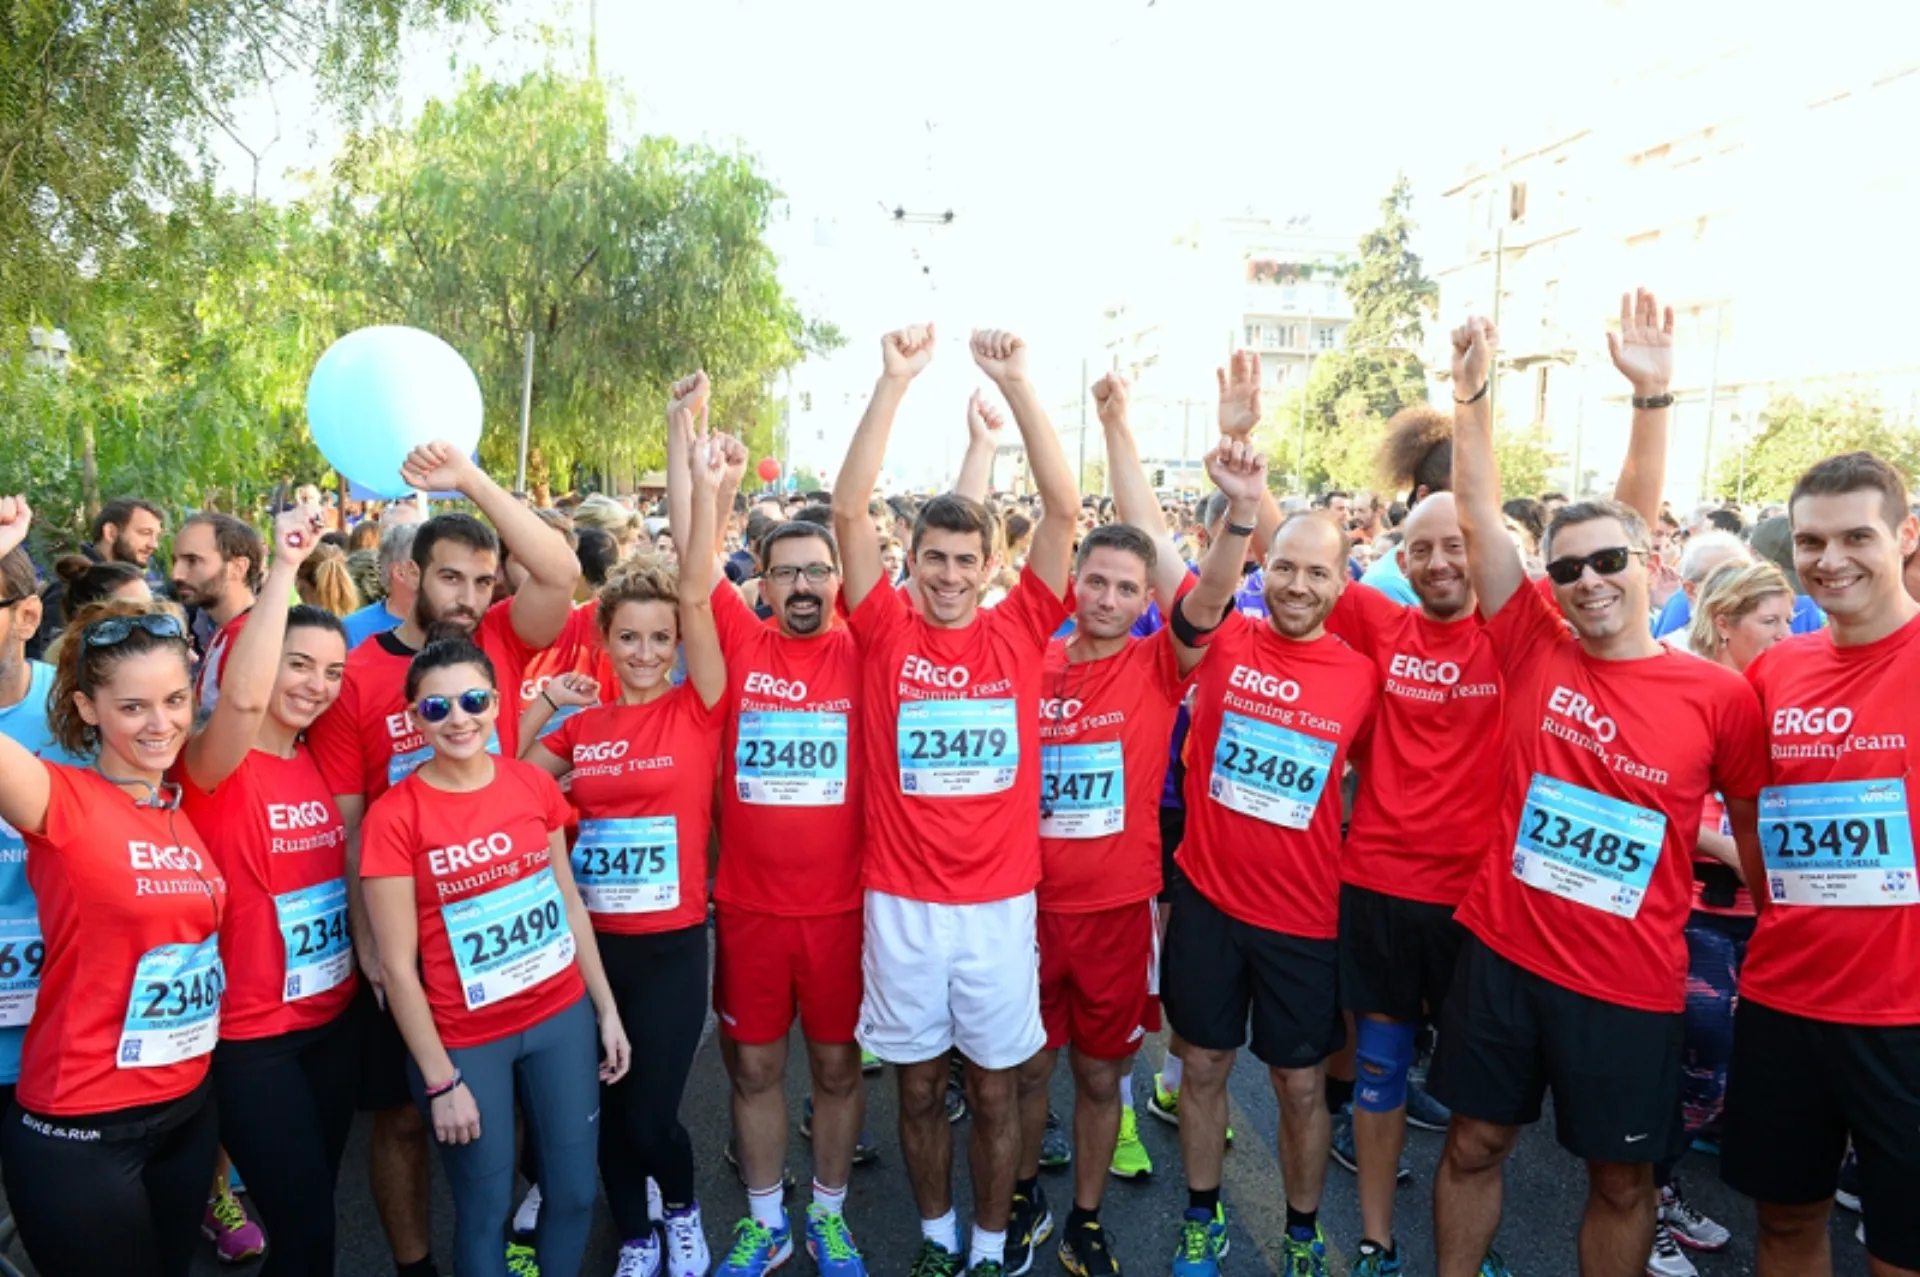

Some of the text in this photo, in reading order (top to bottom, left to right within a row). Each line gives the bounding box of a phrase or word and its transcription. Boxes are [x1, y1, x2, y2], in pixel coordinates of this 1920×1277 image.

[901, 655, 969, 688] ERGO
[1229, 665, 1301, 702] ERGO
[1389, 654, 1460, 685] ERGO
[744, 671, 807, 701] ERGO
[972, 678, 1011, 697] Team
[1451, 684, 1498, 699] Team
[806, 699, 852, 713] Team
[1082, 710, 1124, 730] Team
[1223, 690, 1342, 734] Running Team
[1773, 707, 1854, 735] ERGO
[744, 740, 838, 769] 23480
[909, 728, 1006, 759] 23479
[1844, 734, 1906, 752] Team
[628, 756, 674, 771] Team
[1221, 741, 1316, 793] 23486
[1613, 753, 1669, 785] Team
[1043, 770, 1114, 801] 3477
[268, 801, 329, 830] ERGO
[271, 828, 336, 854] Running
[1528, 808, 1646, 873] 23485
[1772, 819, 1890, 857] 23491
[128, 840, 204, 871] ERGO
[428, 832, 512, 876] ERGO
[581, 846, 666, 876] 23475
[437, 860, 519, 897] Running
[463, 900, 560, 966] 23490
[0, 942, 45, 978] 69
